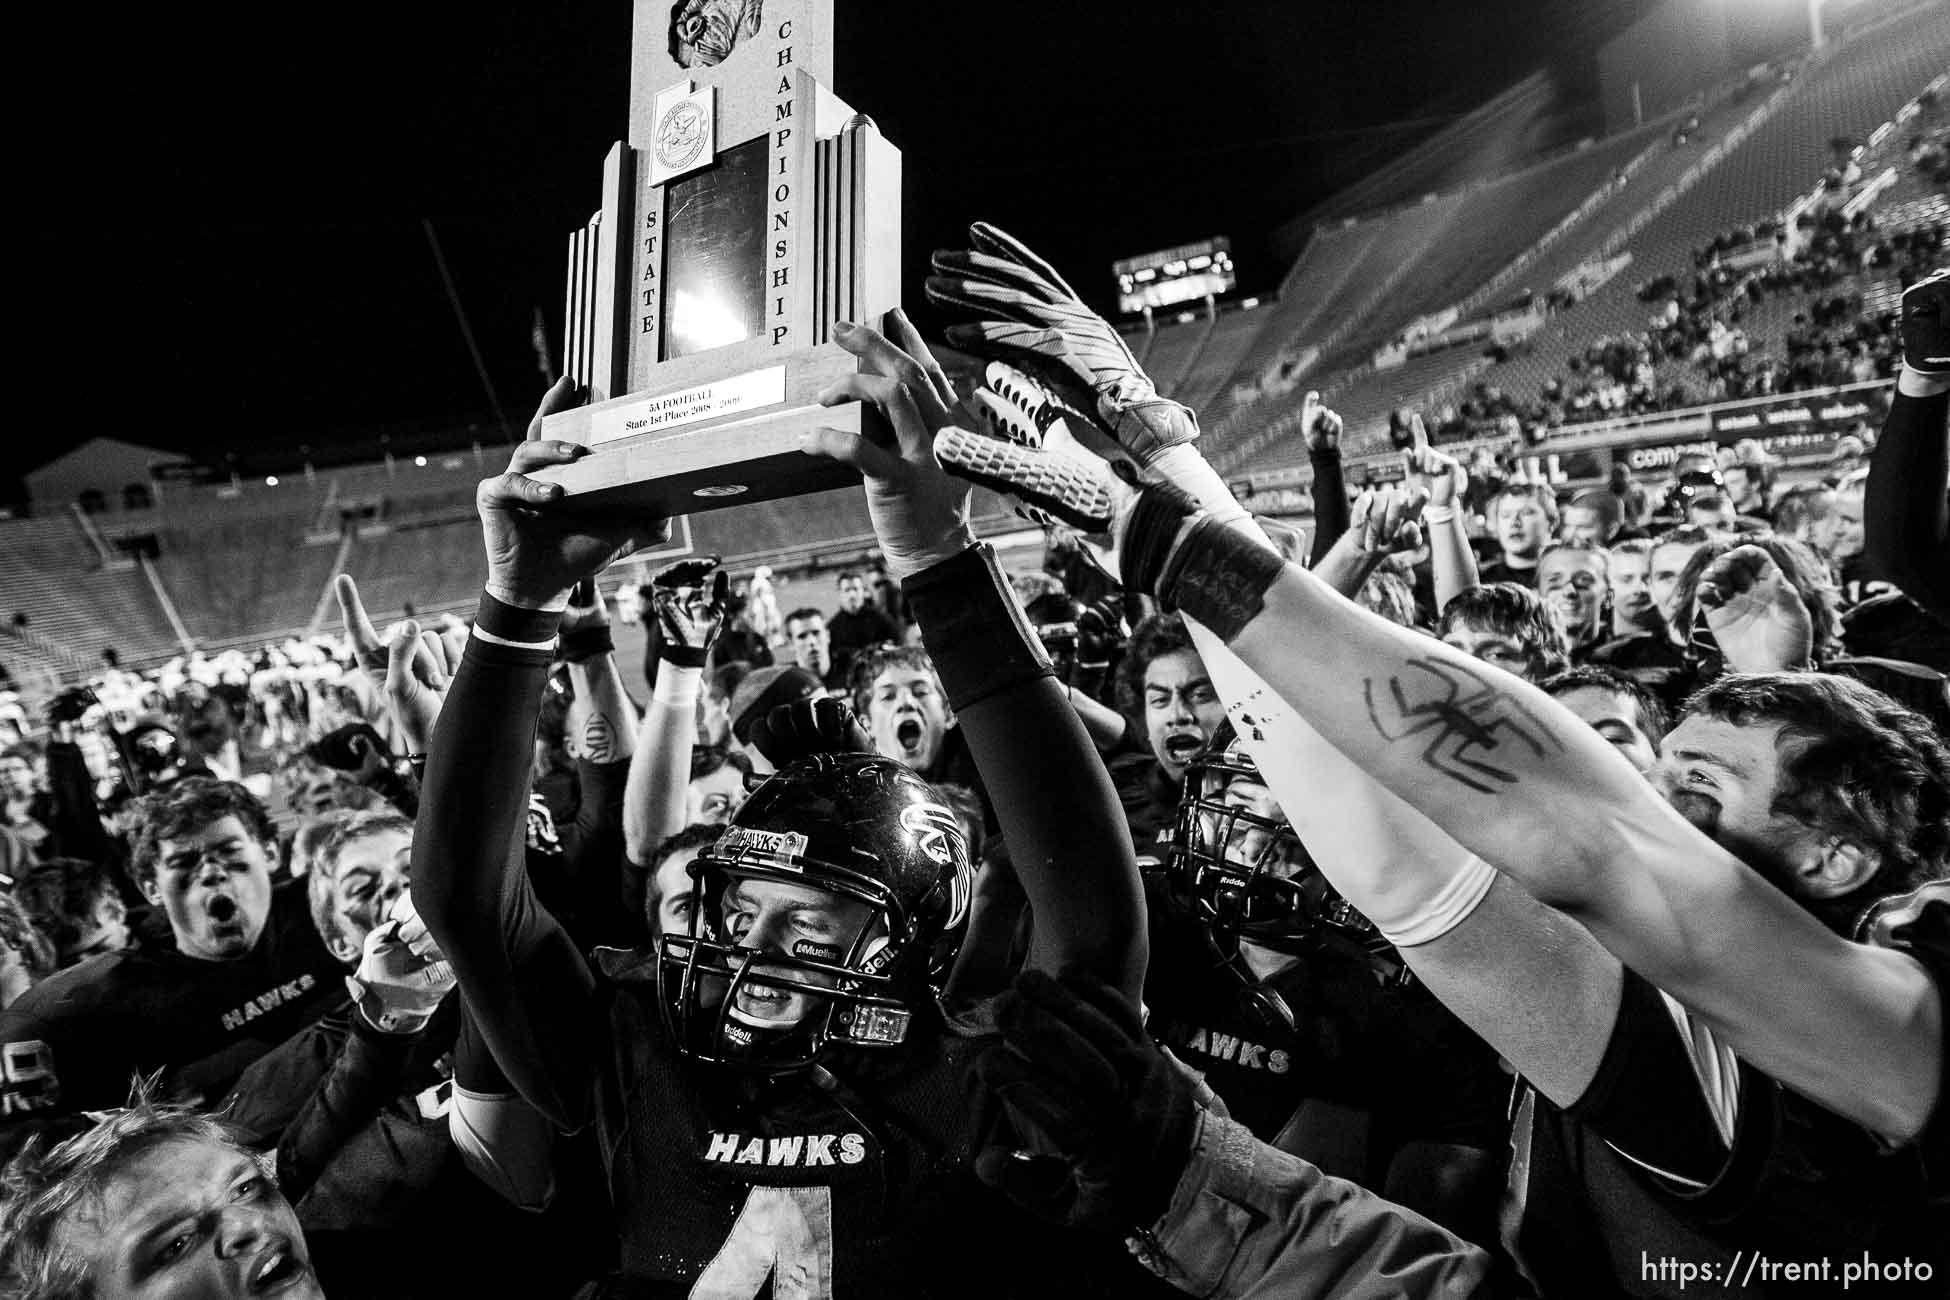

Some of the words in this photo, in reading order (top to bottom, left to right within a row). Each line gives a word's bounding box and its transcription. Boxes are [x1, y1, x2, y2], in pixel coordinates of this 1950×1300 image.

[771, 21, 793, 346] CHAMPIONSHIP
[641, 210, 657, 334] STATE
[625, 418, 648, 431] State
[650, 415, 662, 425] 1st
[665, 410, 689, 422] Place
[649, 403, 661, 413] 5A
[221, 974, 316, 1031] HAWKS
[1185, 1027, 1289, 1074] AWKS
[704, 1132, 866, 1167] HAWKS
